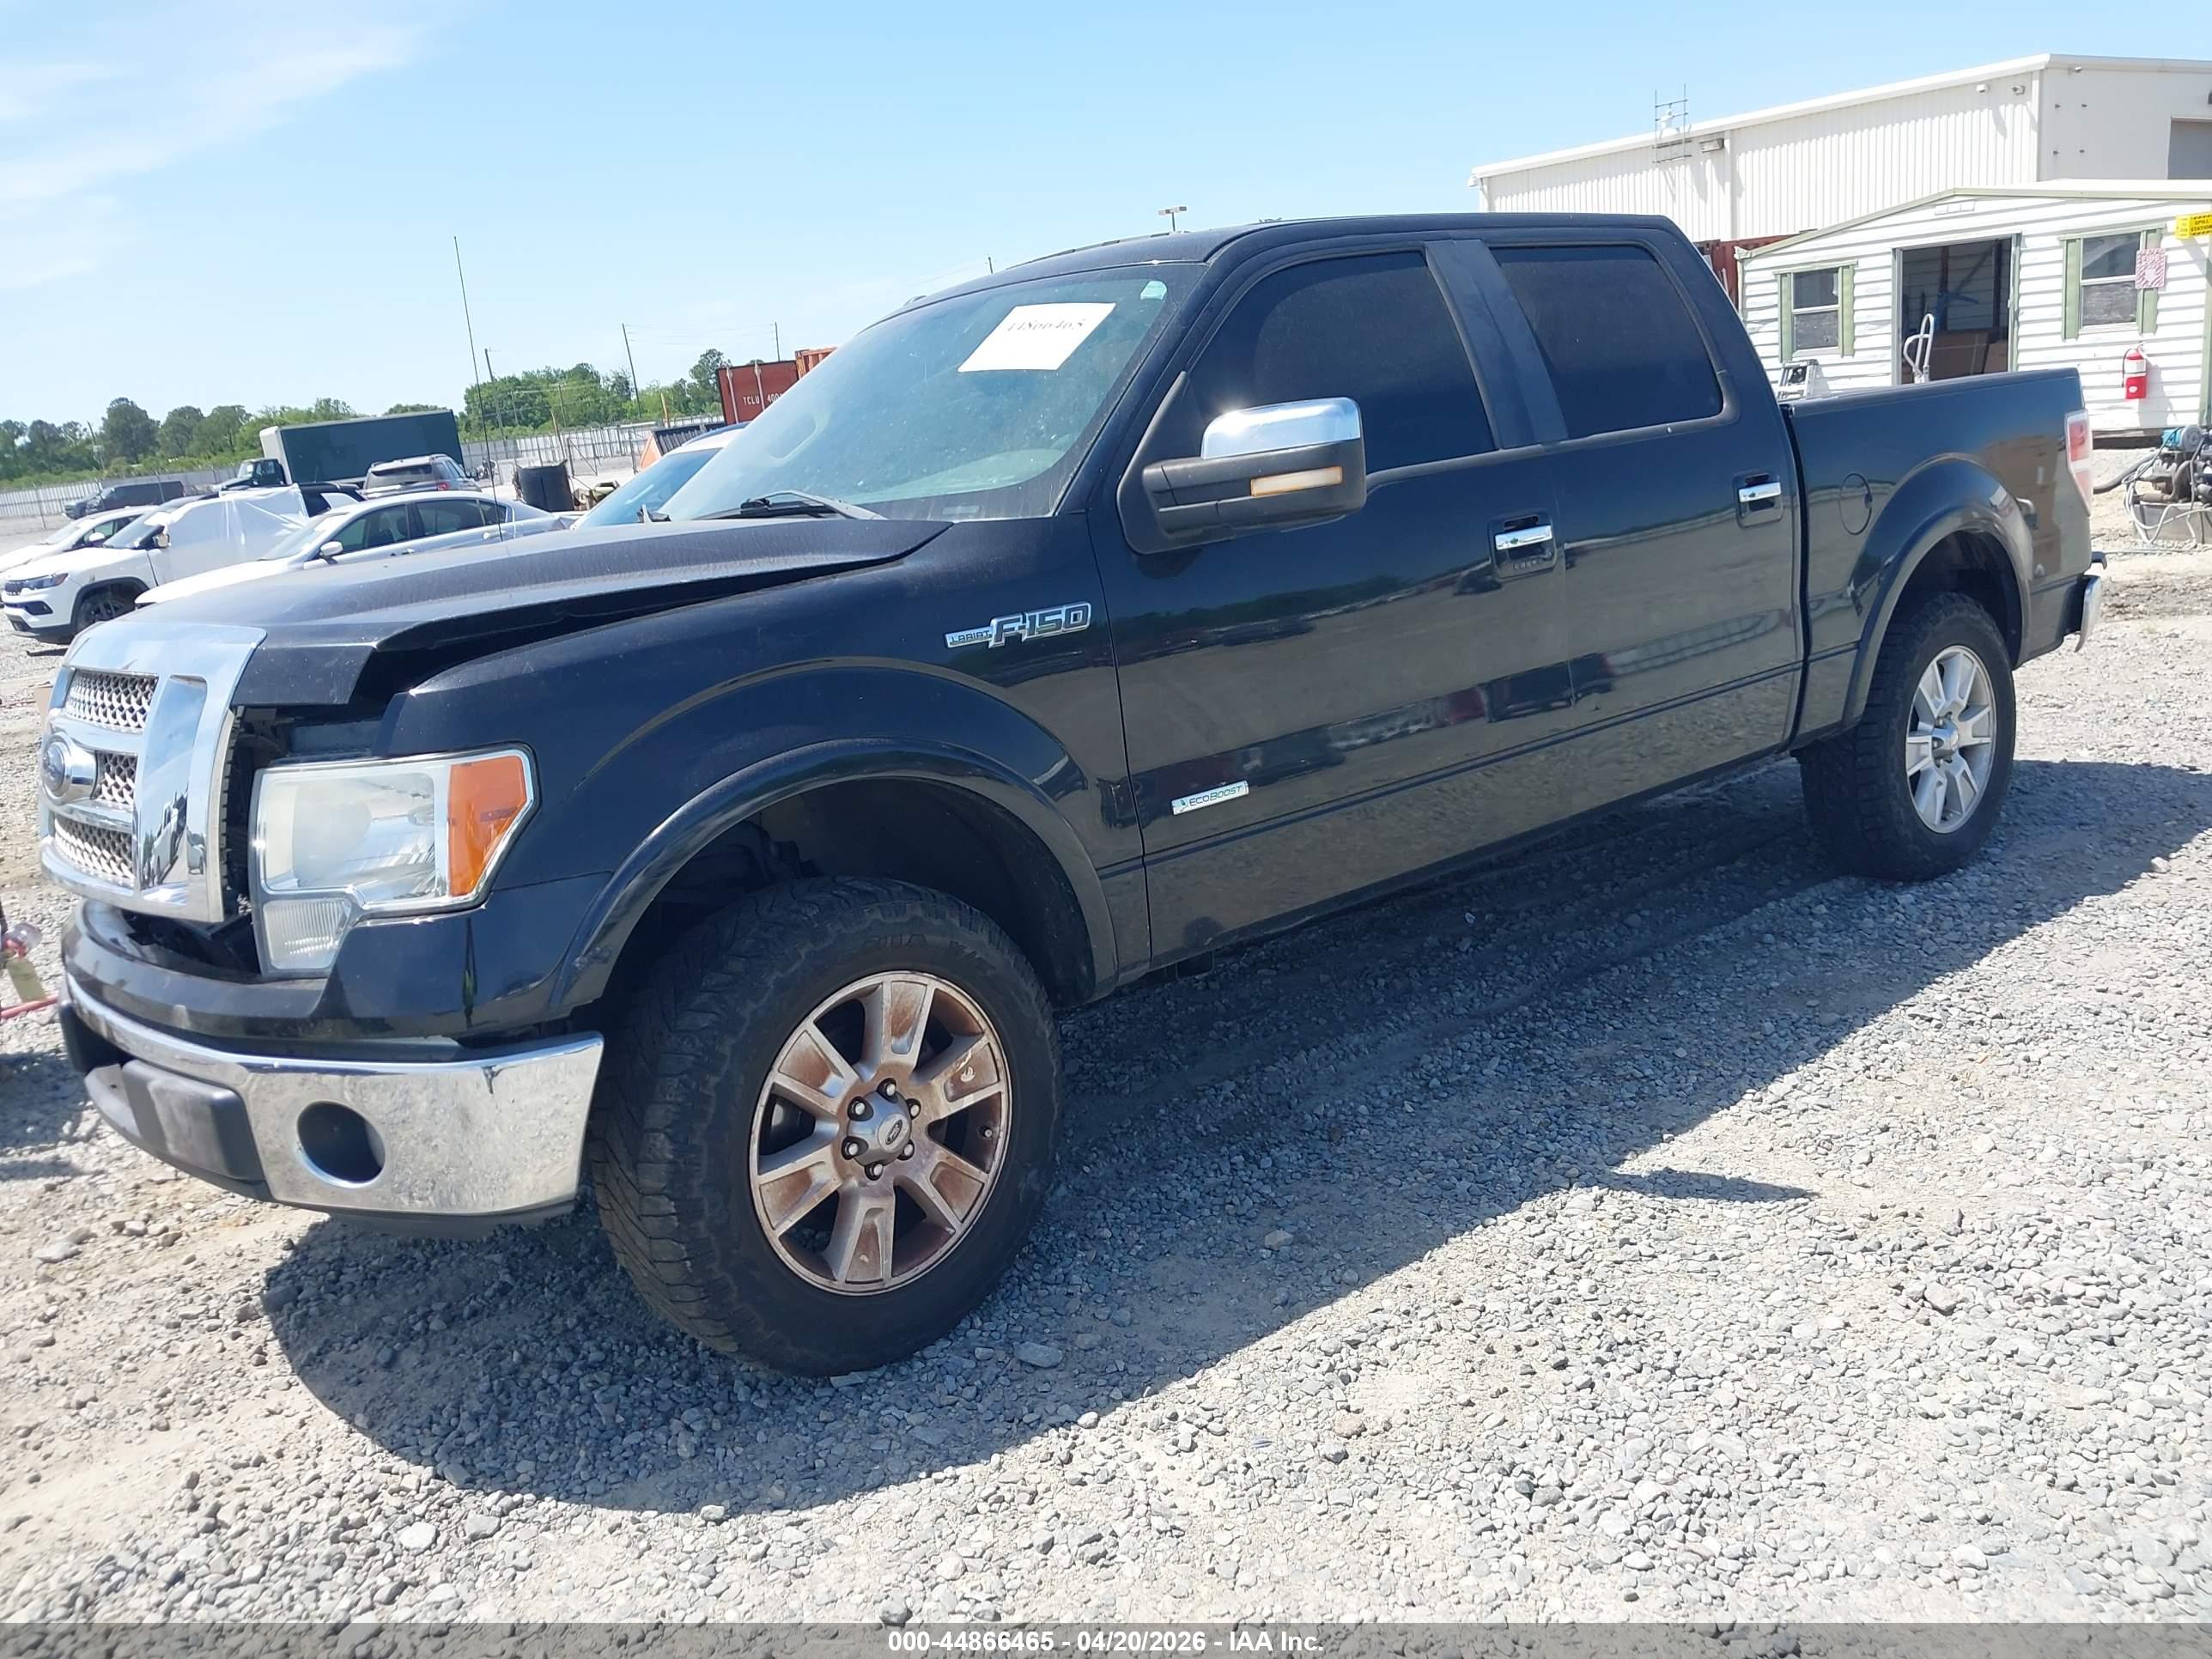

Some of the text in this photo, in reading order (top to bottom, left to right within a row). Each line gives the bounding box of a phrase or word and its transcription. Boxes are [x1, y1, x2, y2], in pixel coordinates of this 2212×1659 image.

[743, 395, 760, 405] TCLU
[951, 601, 1091, 648] LARIAT F-150
